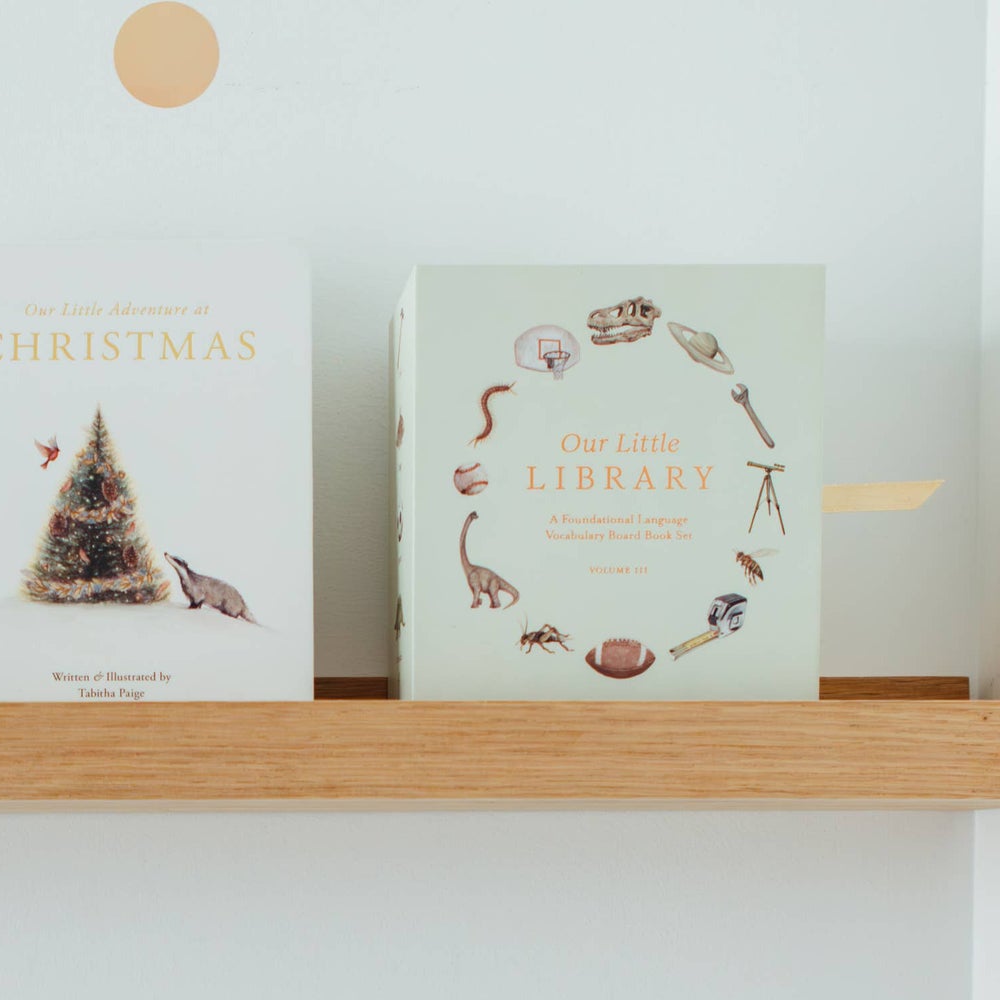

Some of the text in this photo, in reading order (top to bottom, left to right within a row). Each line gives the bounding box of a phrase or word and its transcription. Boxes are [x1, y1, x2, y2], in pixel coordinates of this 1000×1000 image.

[24, 301, 210, 316] Our Little Adventure at
[561, 432, 680, 453] Our Little
[526, 465, 714, 490] LIBRARY
[549, 514, 688, 527] A Foundational Language
[545, 530, 692, 543] Vocabulary Board Book Set
[589, 566, 630, 574] VOLUME
[52, 671, 171, 684] Written & Illustrated by
[78, 688, 145, 700] Tabitha Paige
